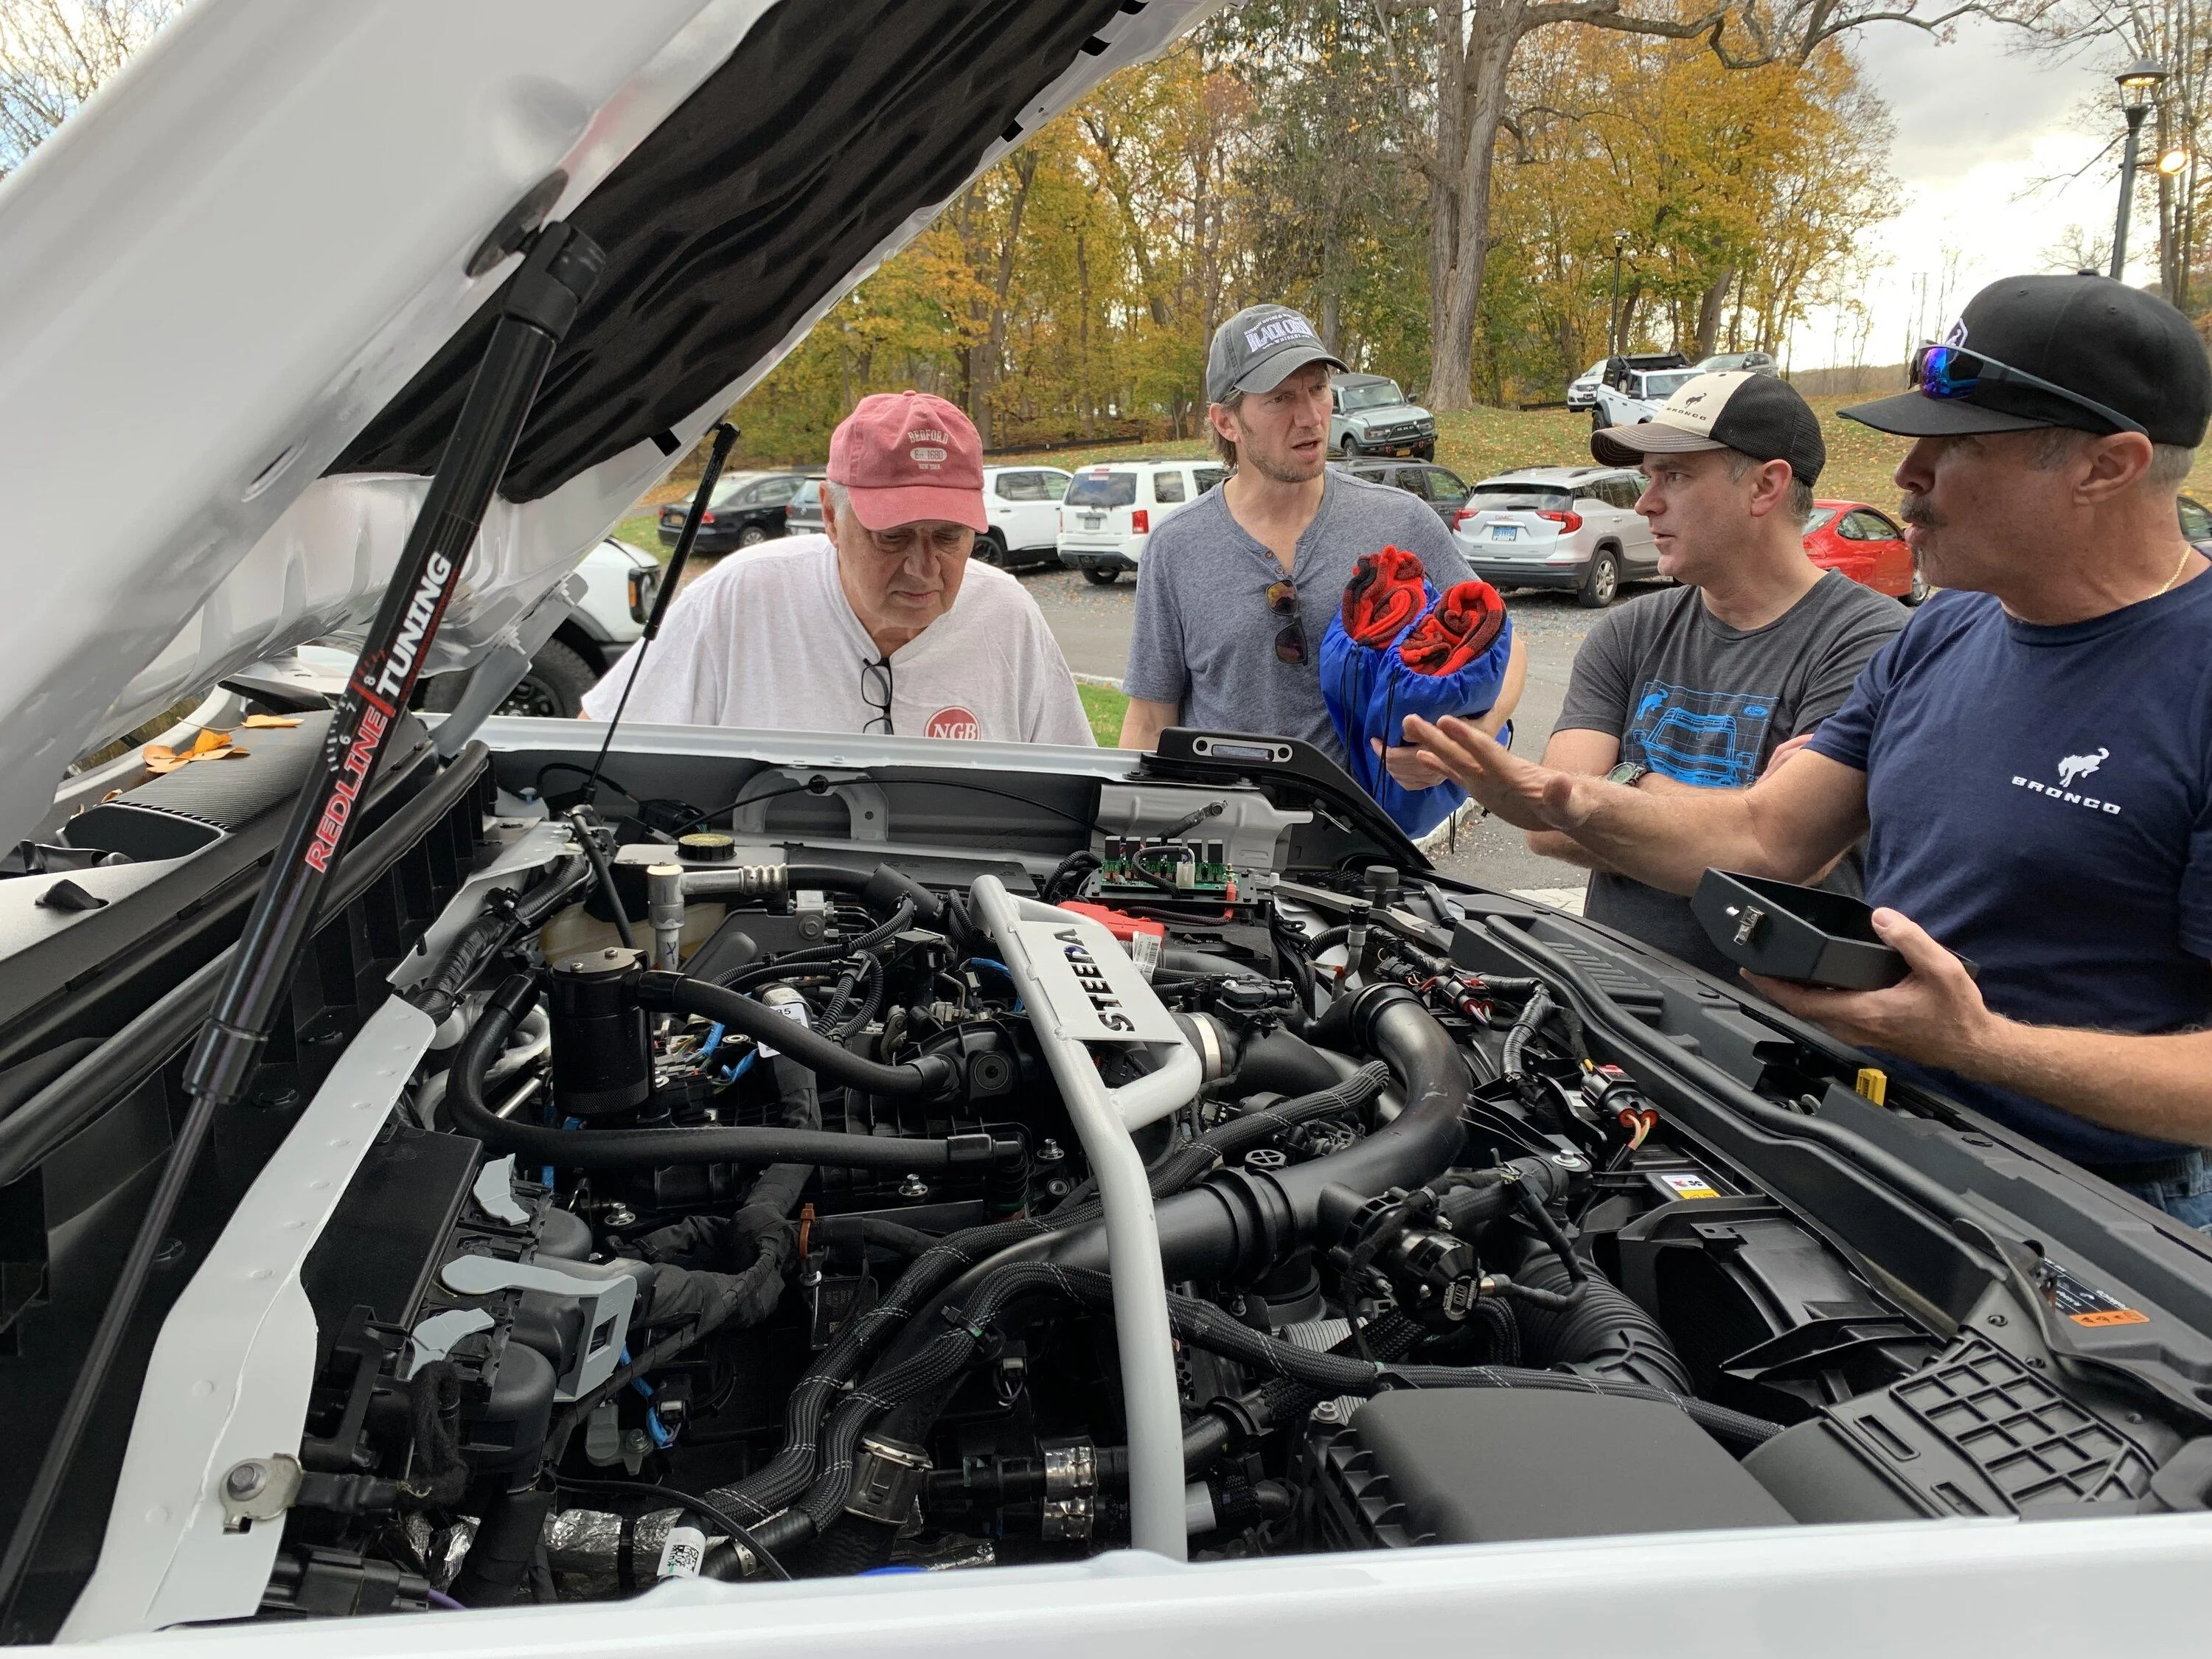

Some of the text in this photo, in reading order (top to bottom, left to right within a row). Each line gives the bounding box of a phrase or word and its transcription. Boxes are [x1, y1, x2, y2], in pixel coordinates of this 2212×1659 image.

[1666, 407, 1707, 421] BRONCO
[908, 429, 949, 444] BEDFORD
[364, 675, 376, 686] 8
[305, 706, 389, 872] REDLINE
[376, 551, 452, 698] TUNING
[346, 702, 358, 713] 7
[339, 734, 352, 745] 6
[2011, 776, 2121, 815] BRONCO
[1054, 928, 1135, 1032] STEEDA
